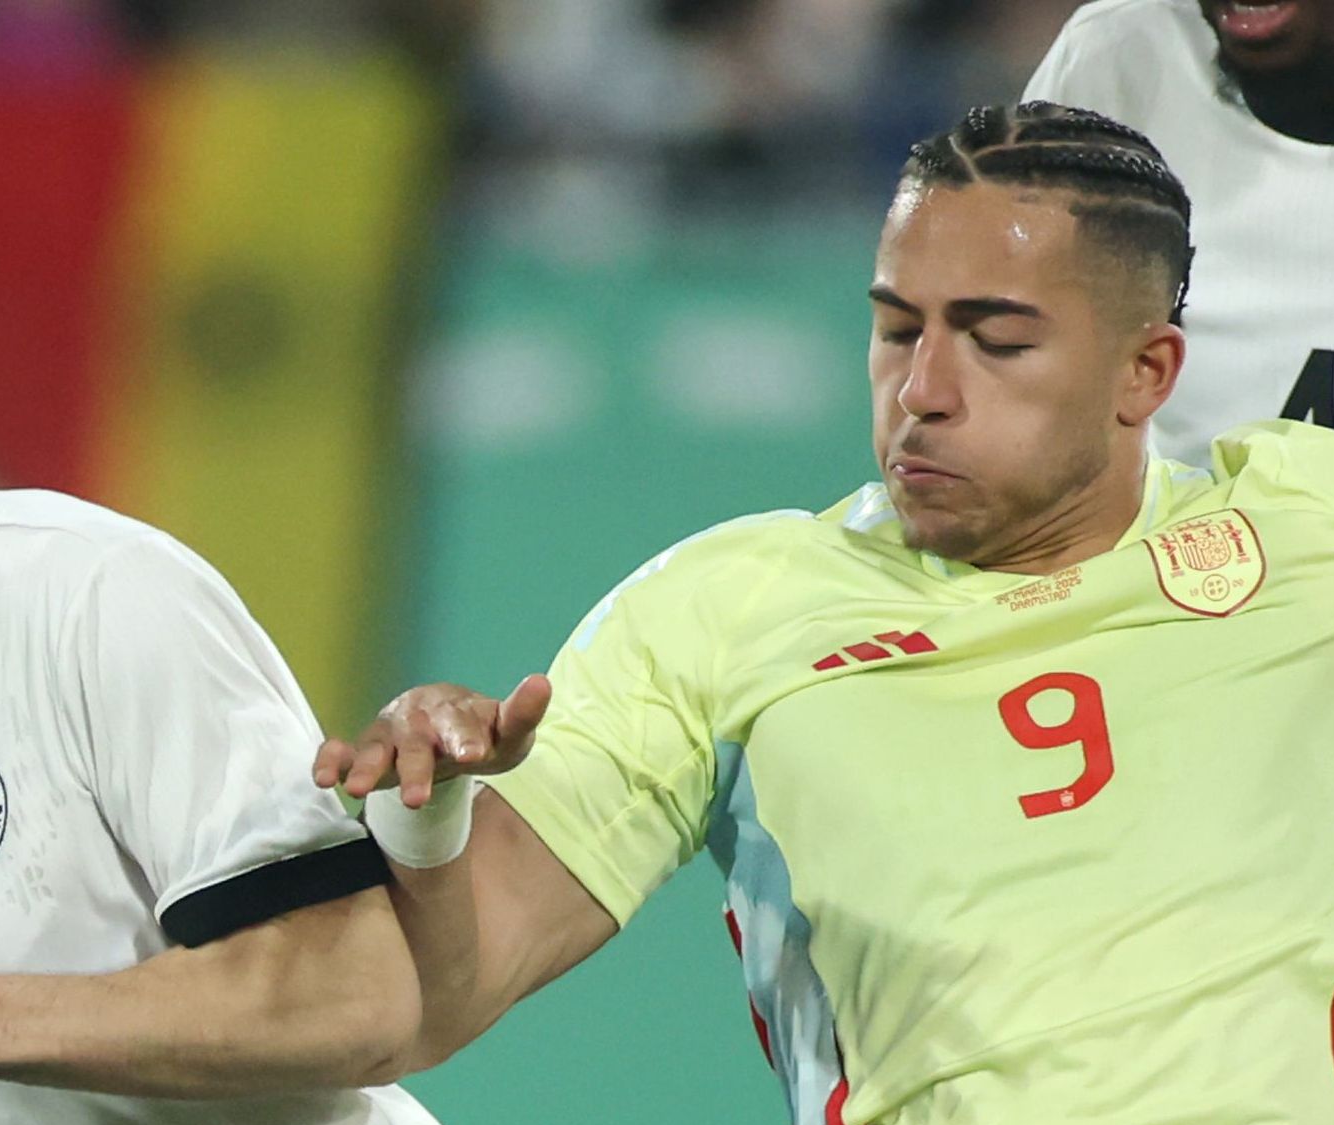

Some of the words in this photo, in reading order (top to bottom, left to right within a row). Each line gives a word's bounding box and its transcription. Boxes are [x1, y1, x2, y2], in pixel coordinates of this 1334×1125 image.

[1055, 574, 1083, 590] 2025
[1010, 588, 1072, 612] DARMSTADT
[998, 672, 1115, 819] 9
